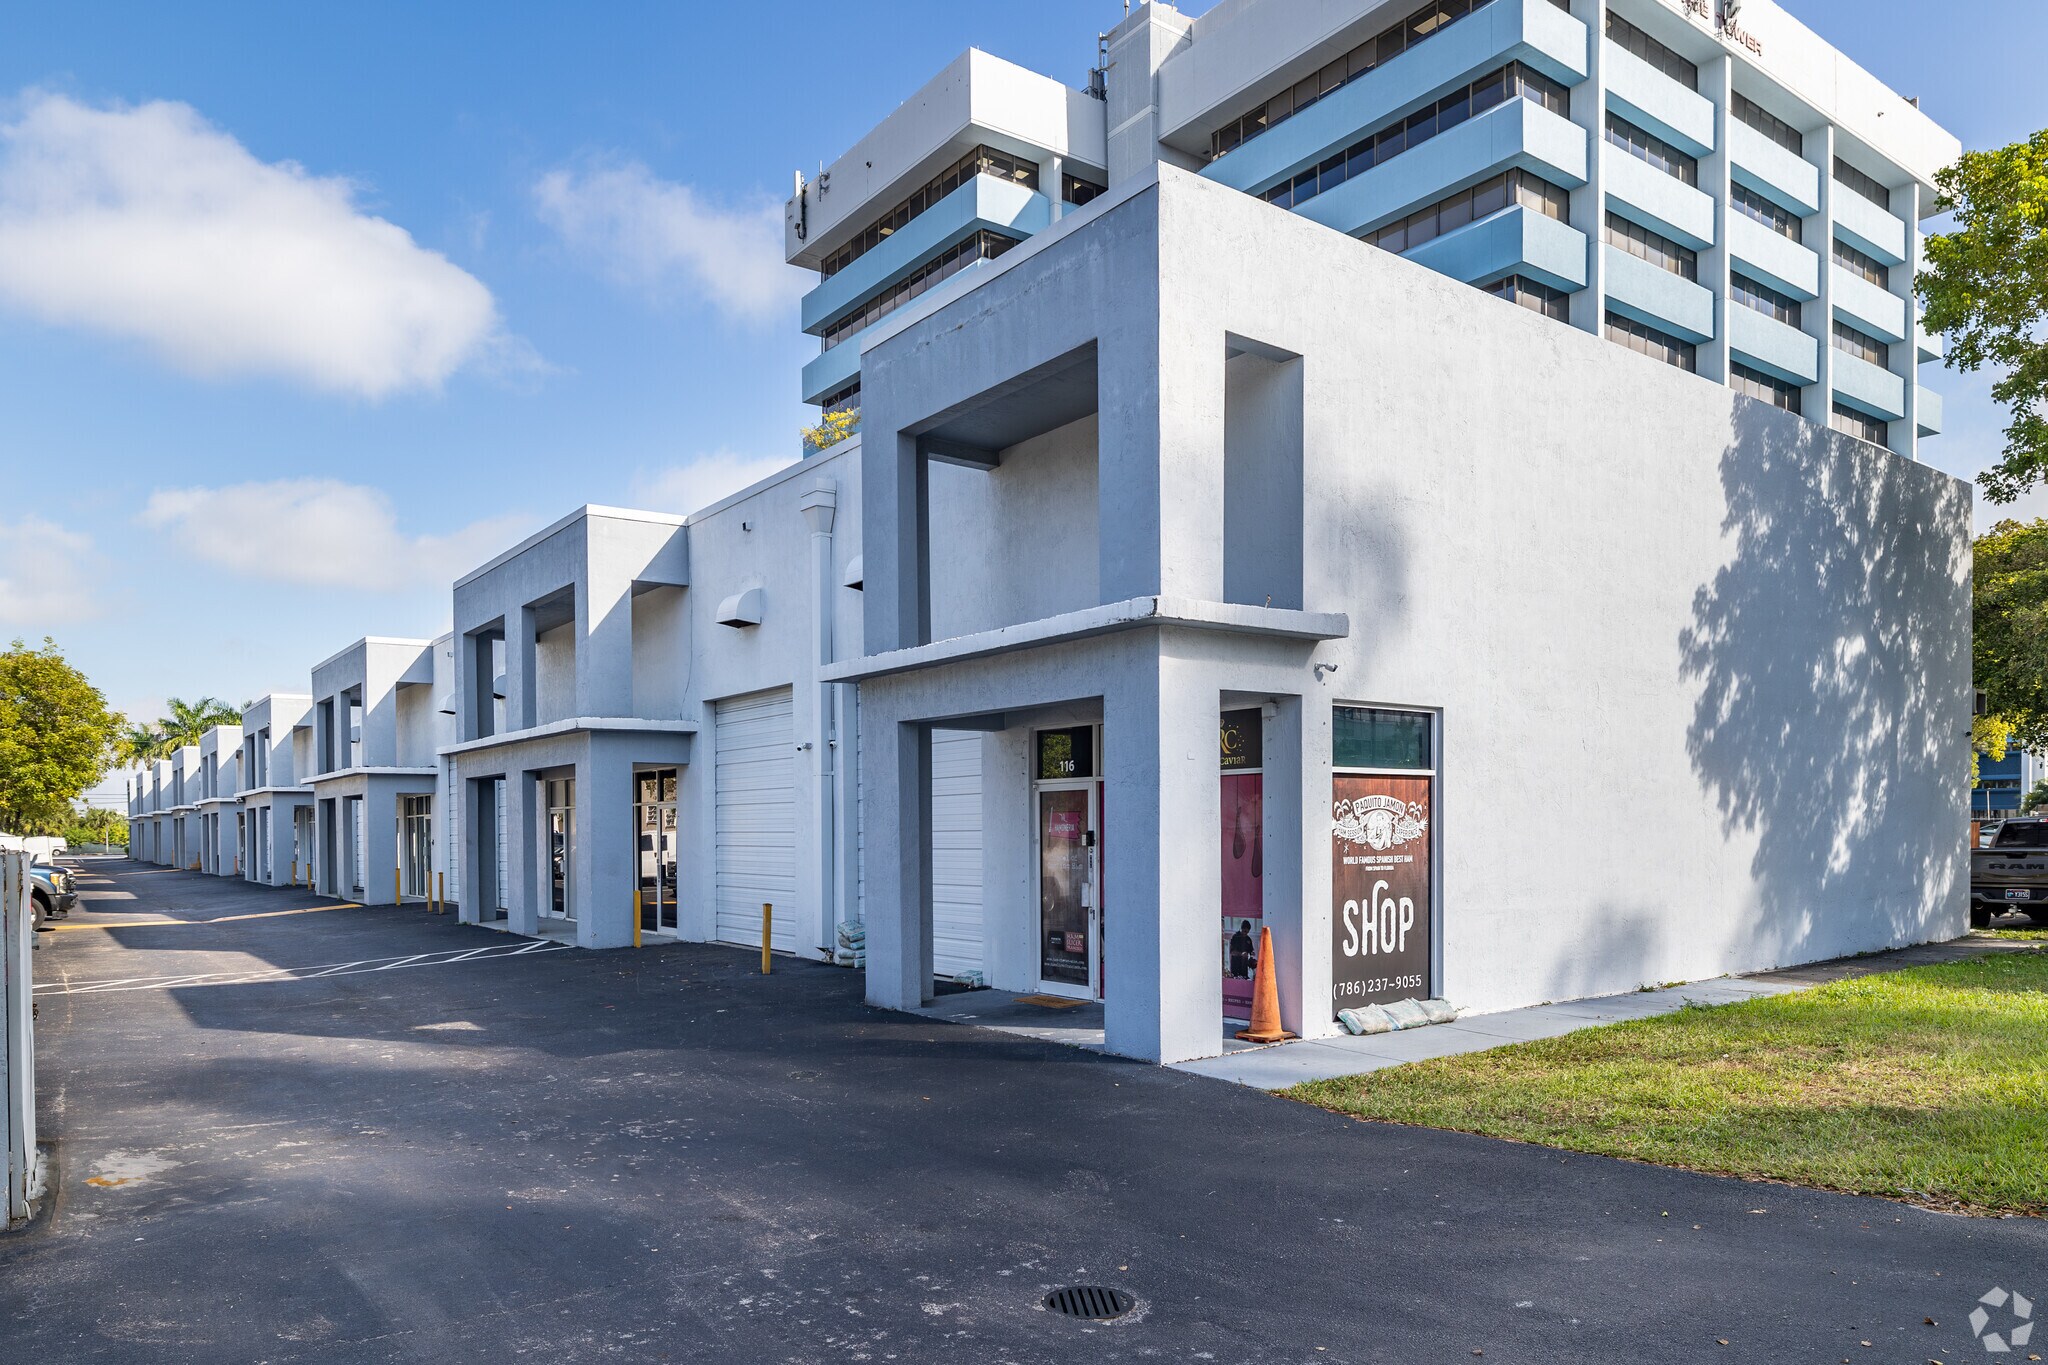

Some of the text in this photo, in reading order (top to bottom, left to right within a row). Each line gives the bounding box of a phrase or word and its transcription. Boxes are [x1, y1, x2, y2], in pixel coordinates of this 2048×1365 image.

[1059, 760, 1075, 772] 116
[1355, 797, 1405, 813] PAQUITO JAMON
[1343, 855, 1413, 865] WORLD FAMOUS SPANISH BEST HAM
[1343, 880, 1414, 957] SHOP
[1333, 975, 1422, 1000] (786)237-9055
